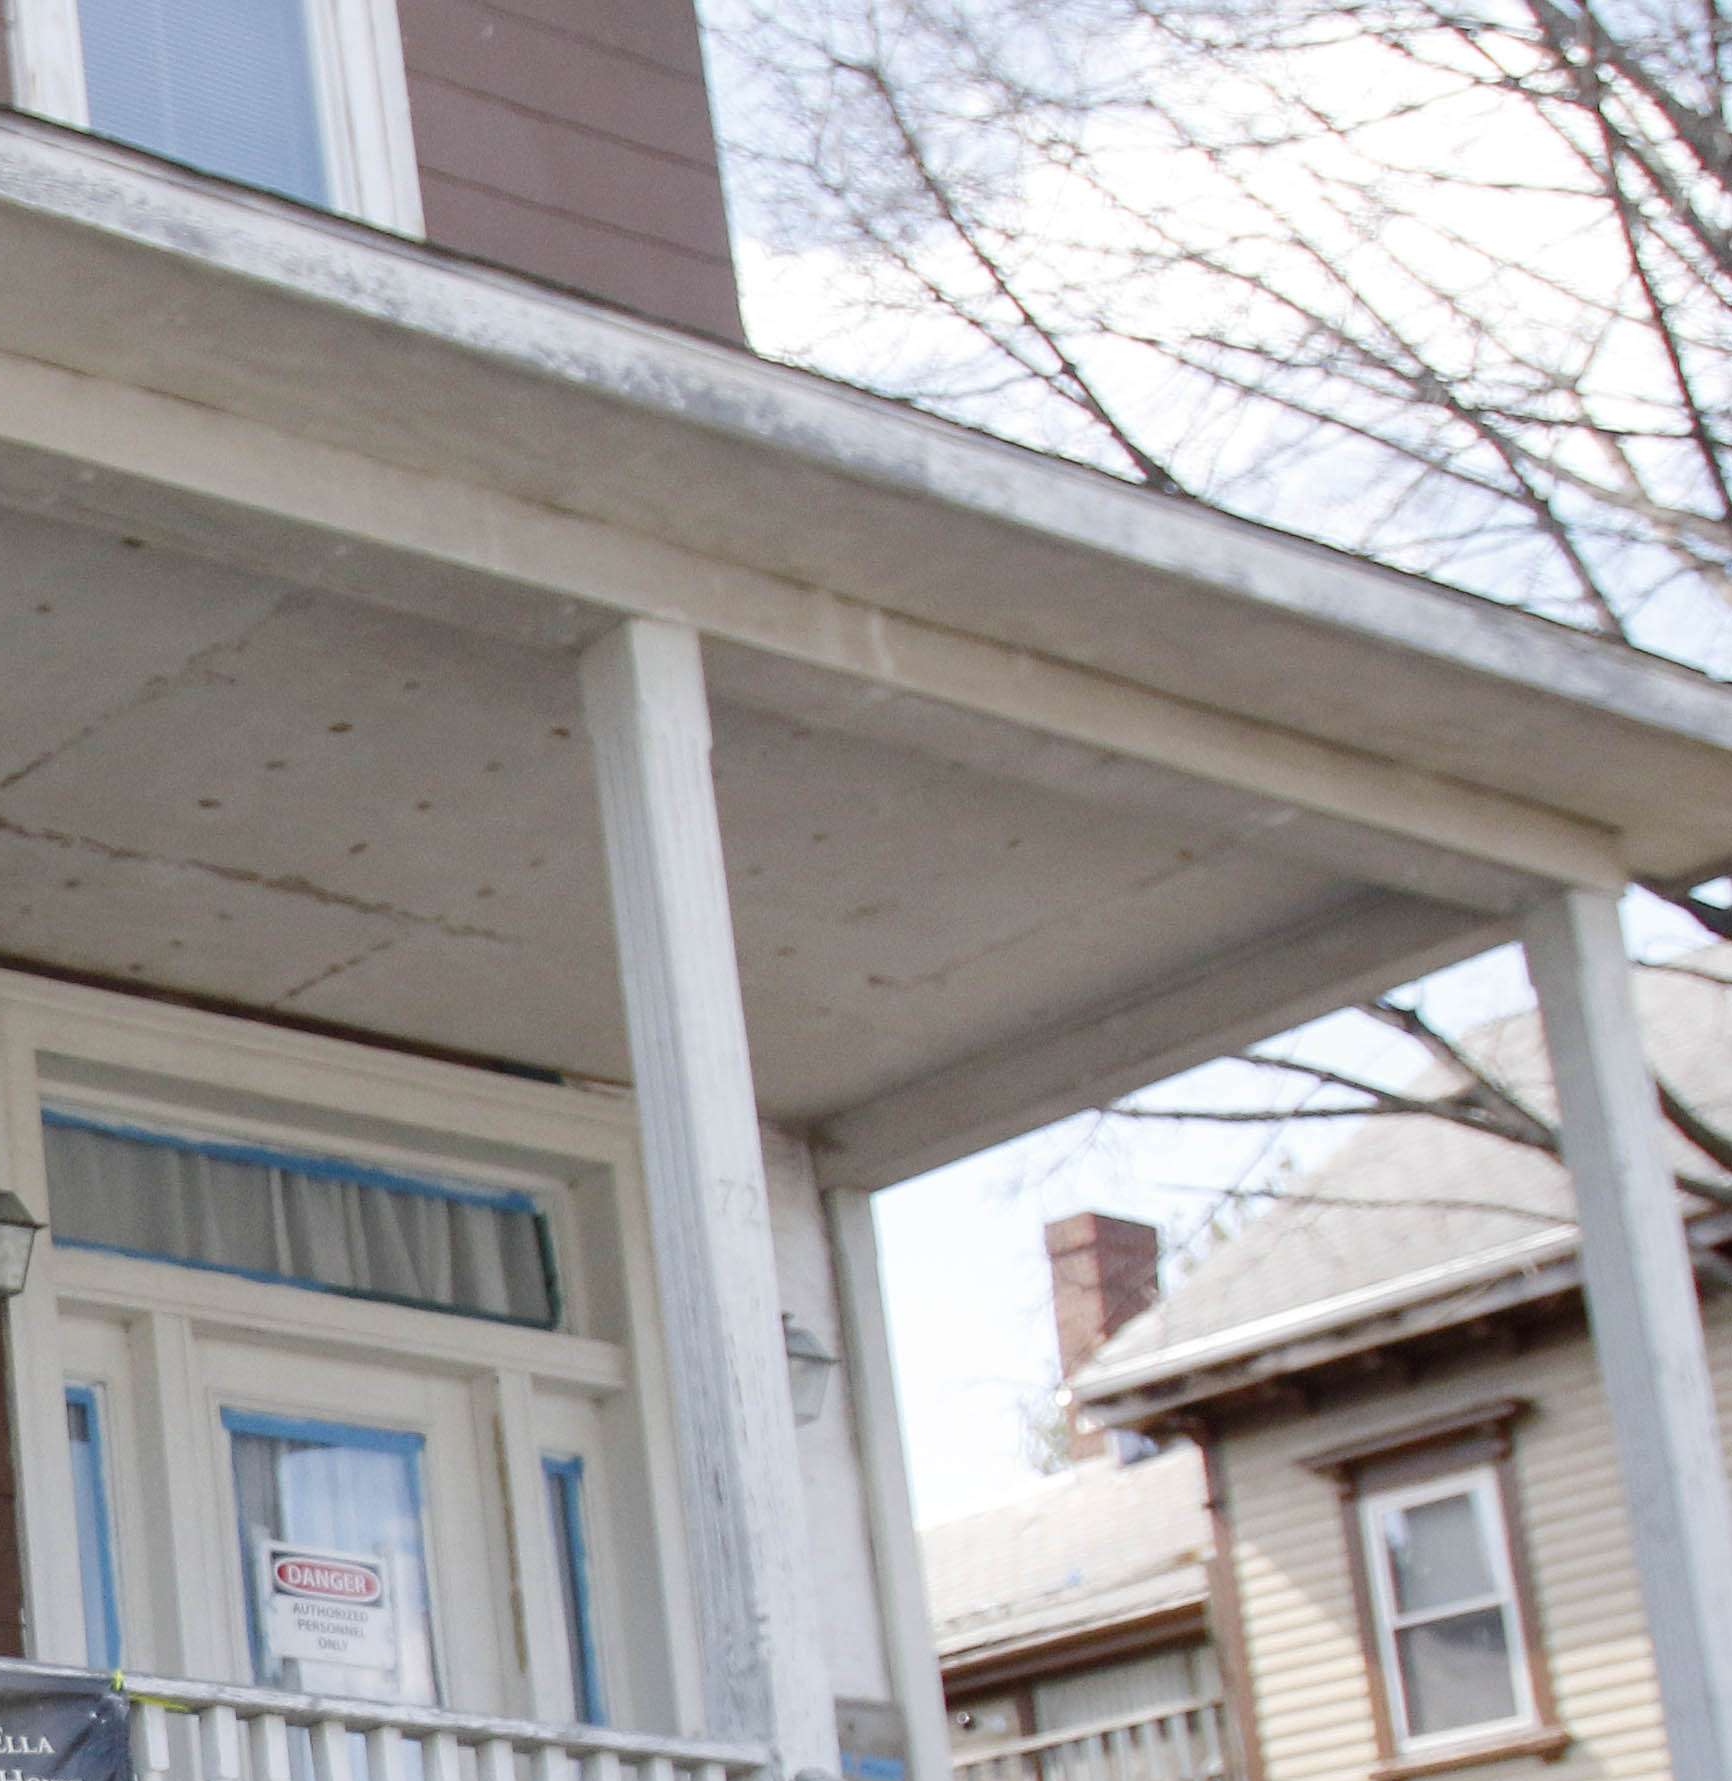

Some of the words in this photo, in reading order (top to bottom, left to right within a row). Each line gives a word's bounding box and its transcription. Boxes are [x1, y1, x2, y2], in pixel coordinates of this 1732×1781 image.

[287, 1565, 367, 1594] DANGER
[292, 1602, 368, 1622] AUTHORIZED
[297, 1619, 365, 1638] PERSONNEL
[318, 1637, 349, 1650] ONLY
